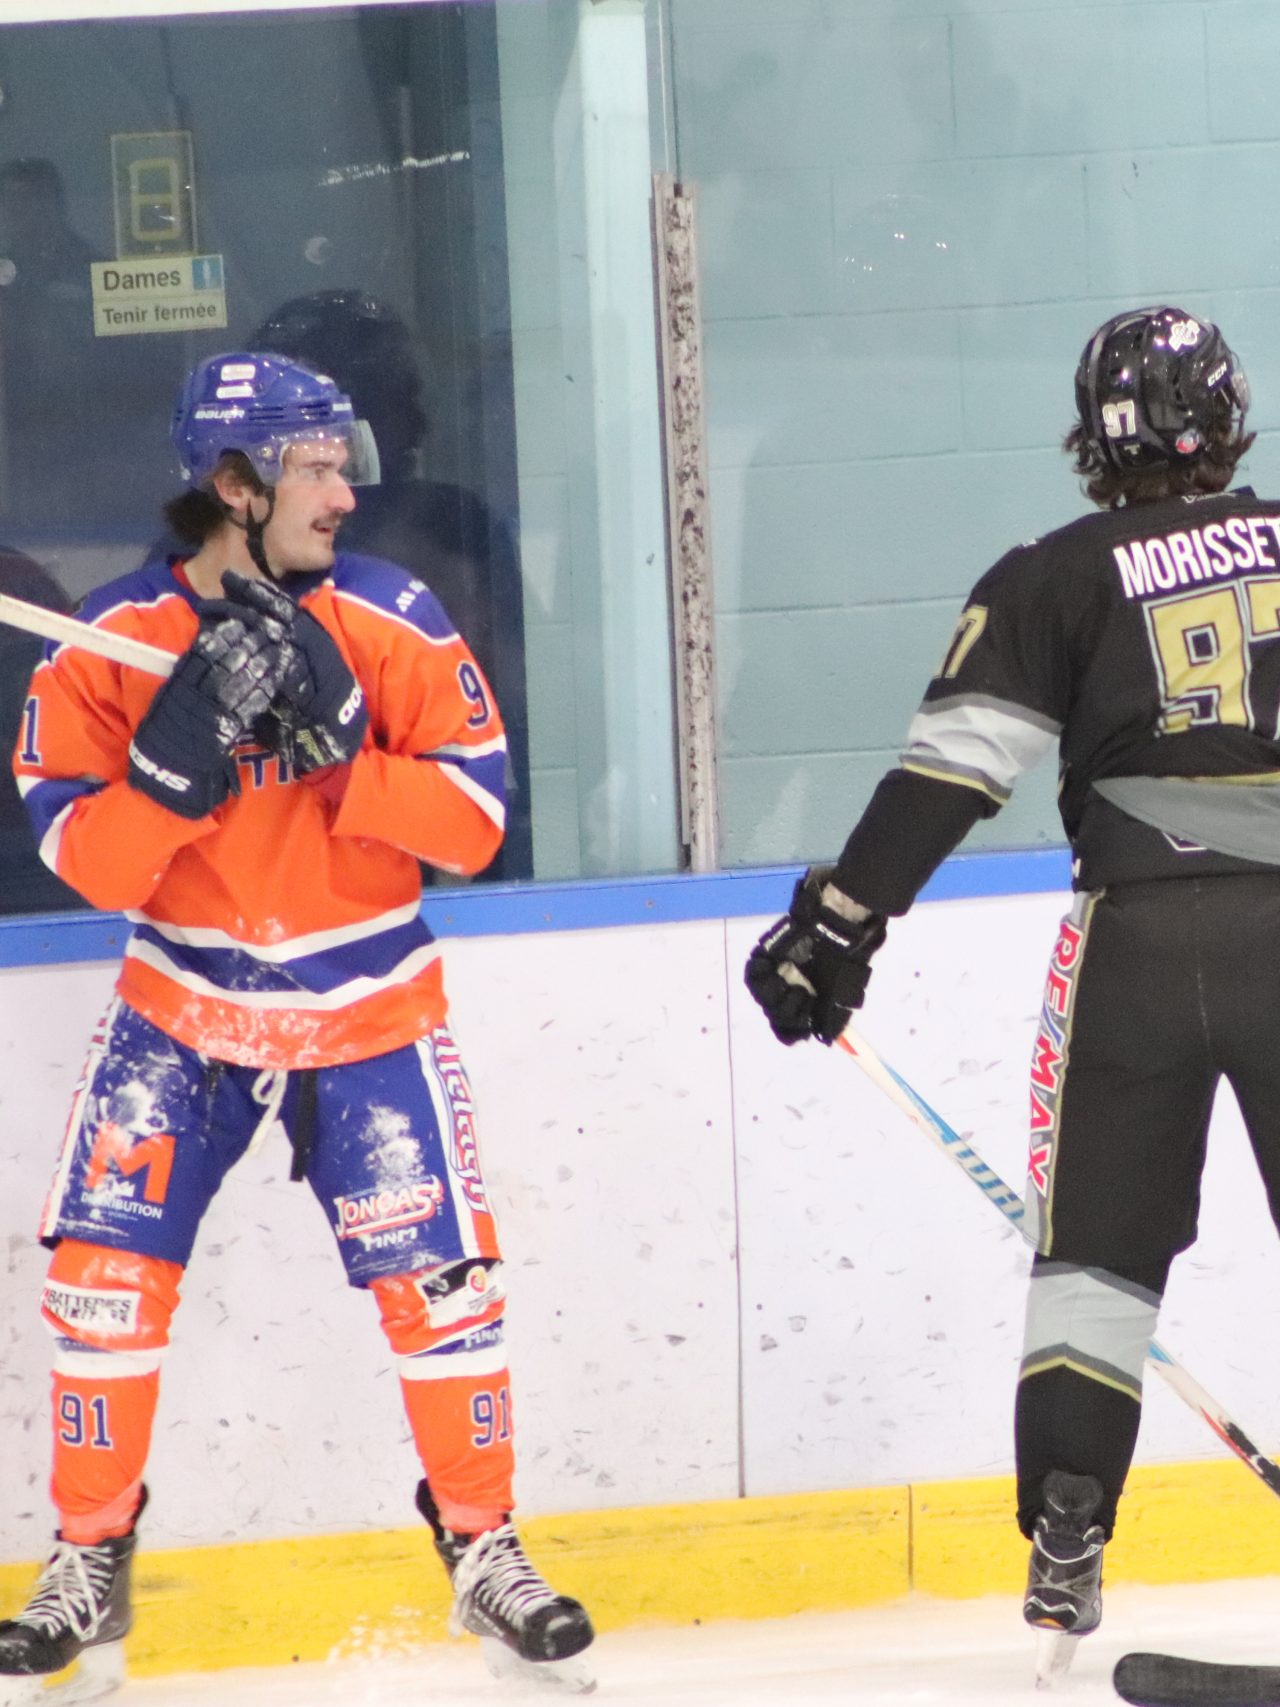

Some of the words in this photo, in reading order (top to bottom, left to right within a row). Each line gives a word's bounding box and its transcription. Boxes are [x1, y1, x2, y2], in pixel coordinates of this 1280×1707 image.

[103, 270, 182, 291] Dames
[102, 307, 148, 324] Tenir
[1102, 400, 1137, 438] 97
[456, 660, 494, 730] 9
[59, 1391, 113, 1449] 91
[471, 1387, 510, 1449] 91
